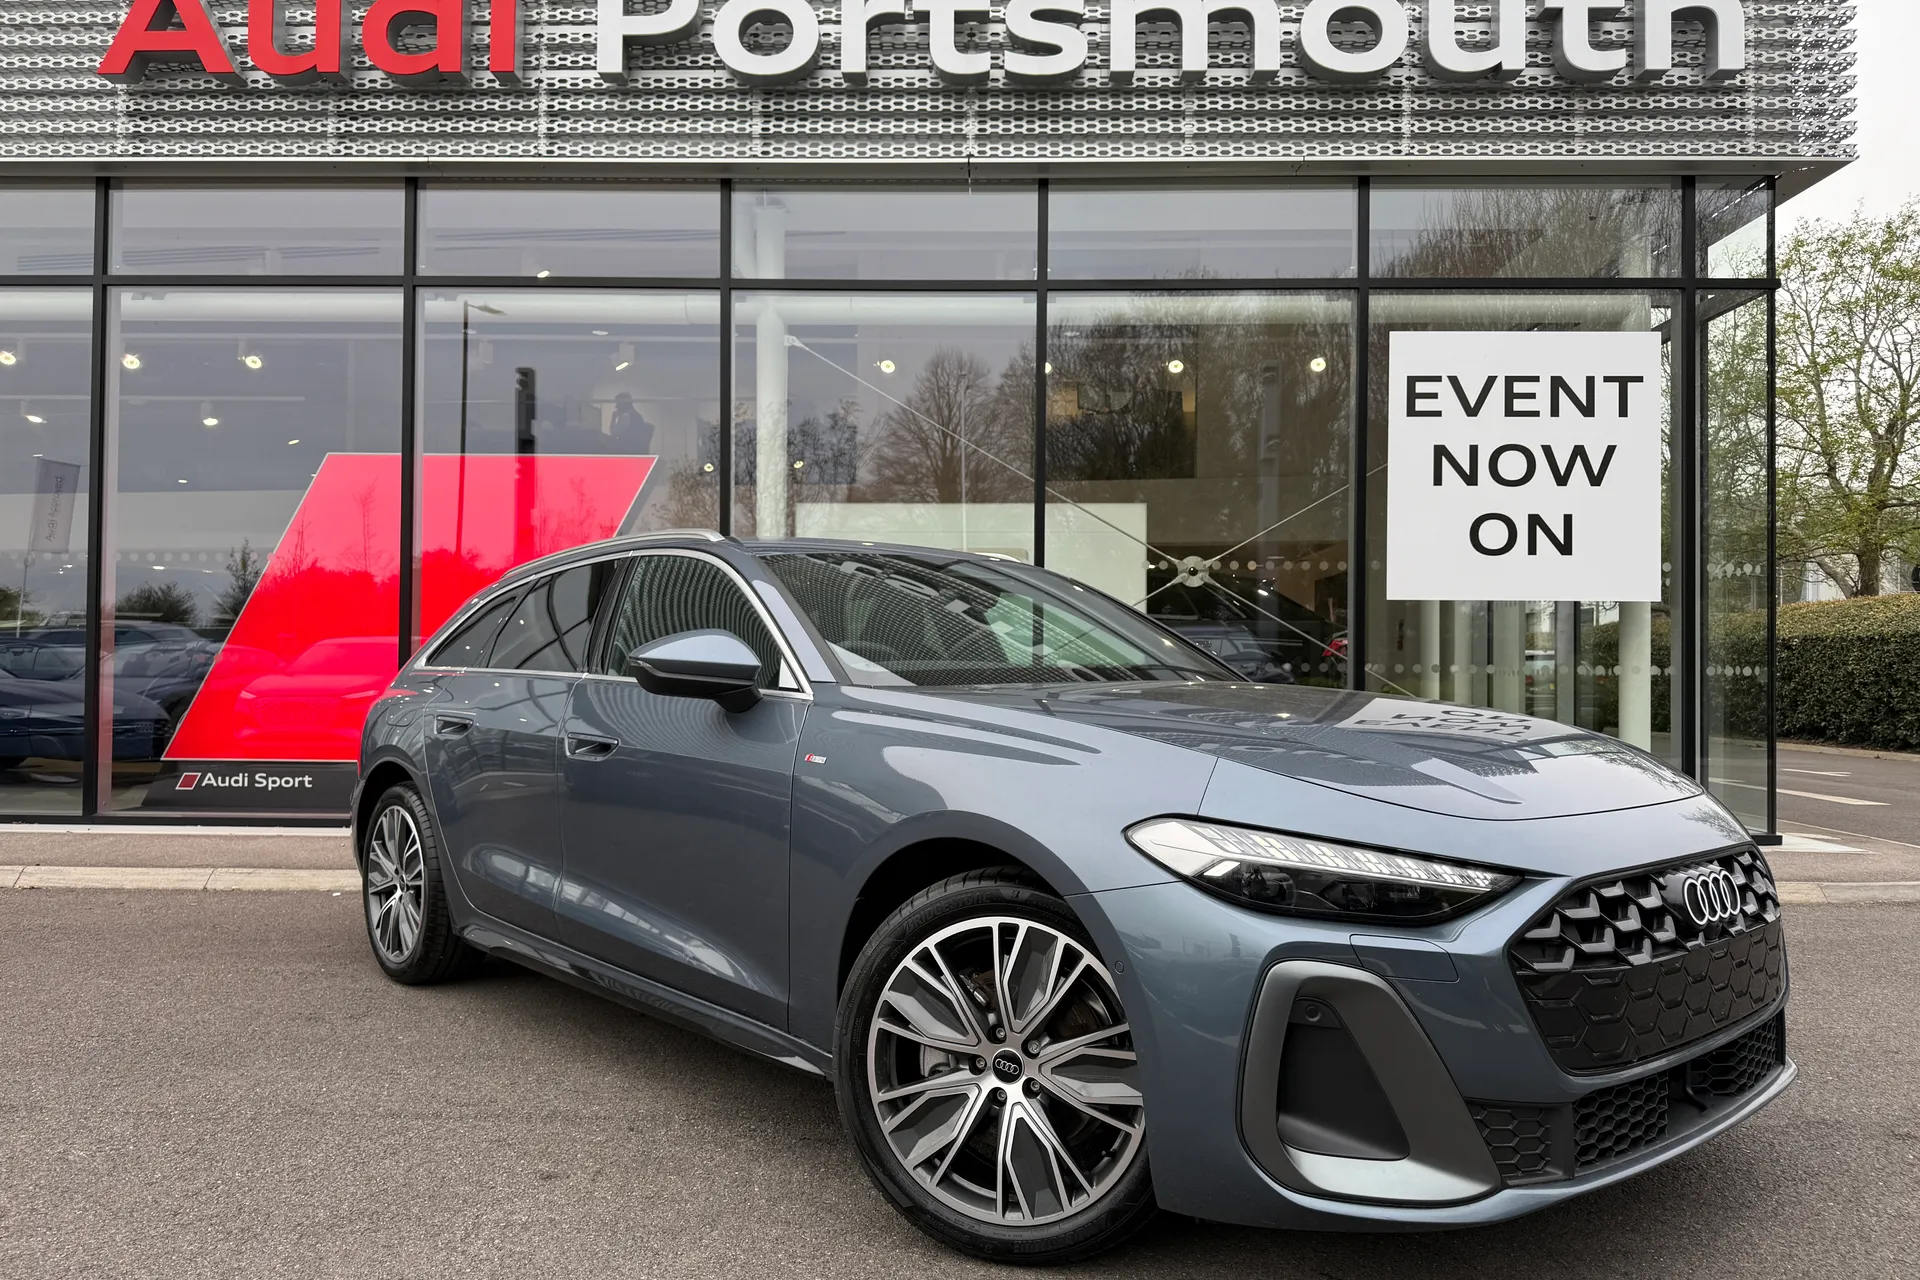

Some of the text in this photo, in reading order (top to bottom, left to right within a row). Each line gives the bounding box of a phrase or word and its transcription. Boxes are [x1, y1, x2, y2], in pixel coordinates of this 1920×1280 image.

[97, 0, 1746, 80] Audi Portsmouth
[1406, 375, 1645, 418] EVENT
[1432, 443, 1618, 488] NOW
[1468, 512, 1574, 557] ON
[201, 772, 313, 791] Audi Sport
